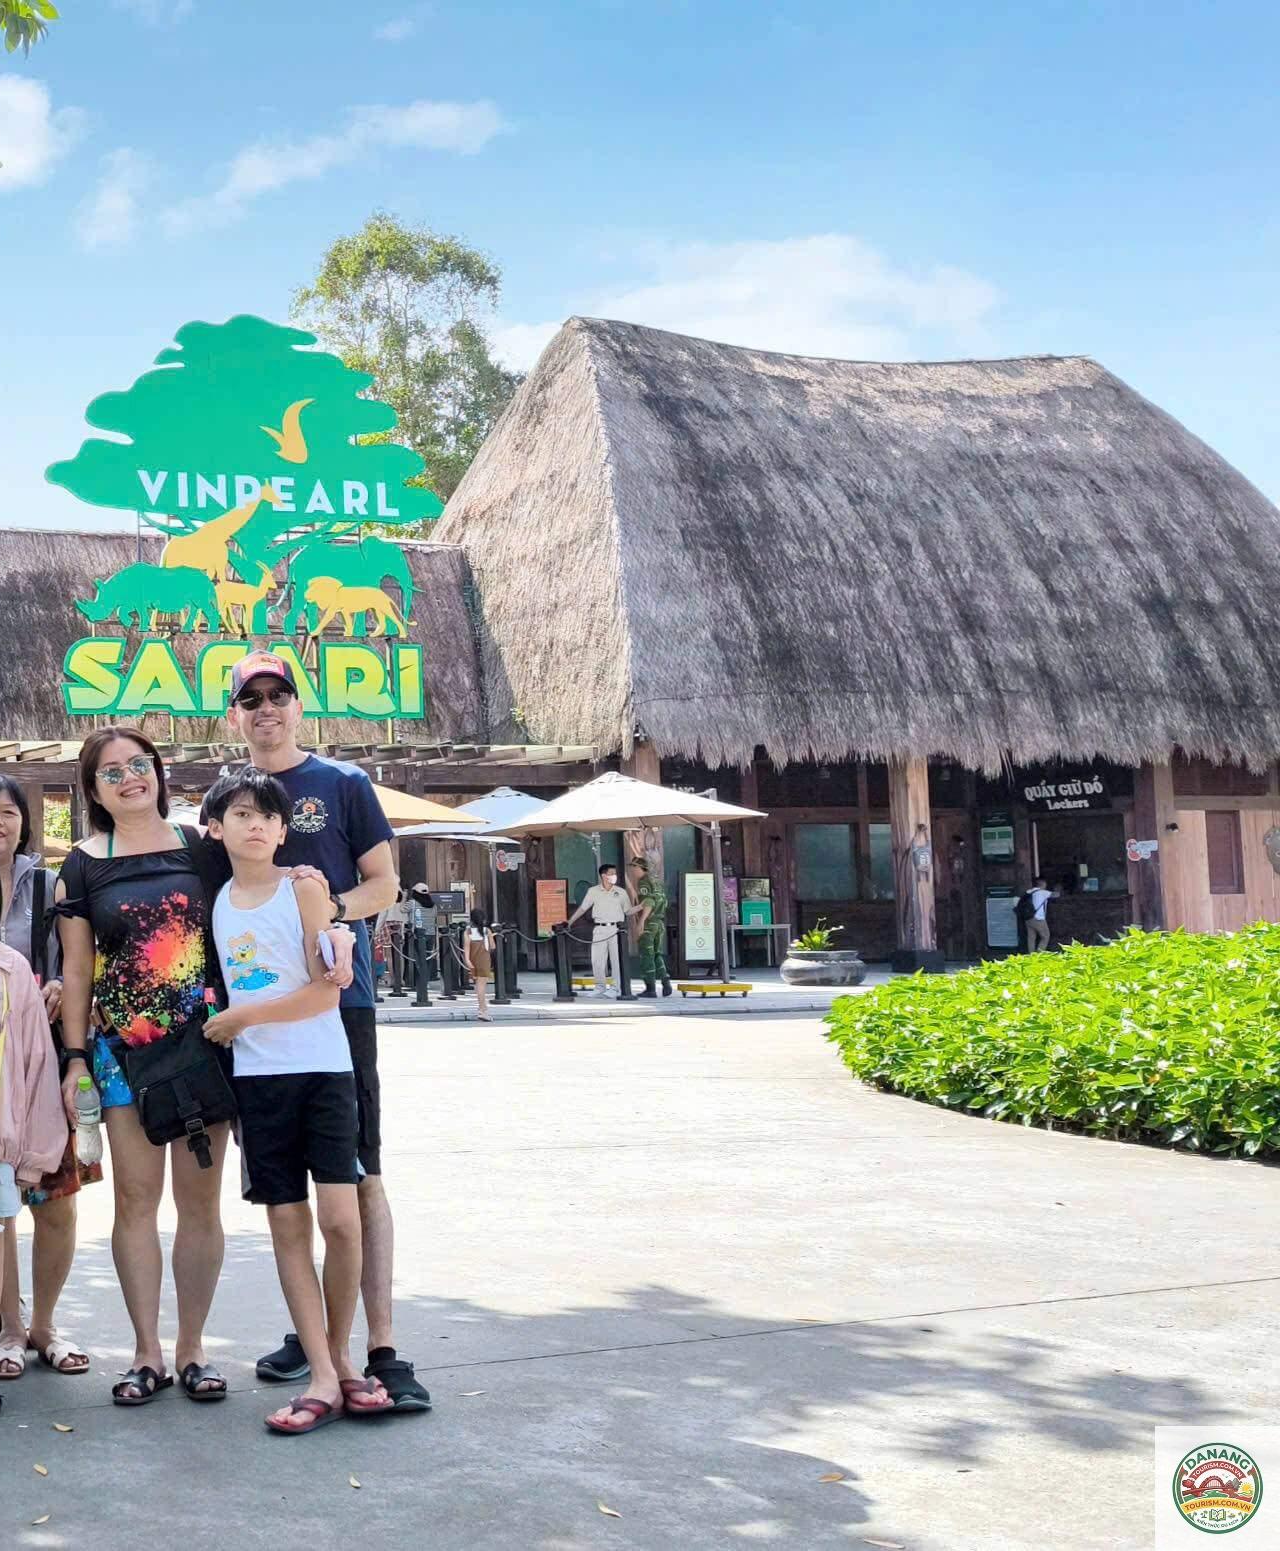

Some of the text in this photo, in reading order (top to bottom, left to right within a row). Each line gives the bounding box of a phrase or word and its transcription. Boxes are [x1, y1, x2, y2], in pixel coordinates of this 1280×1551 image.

[137, 469, 400, 517] VINPEARL
[62, 636, 424, 719] SAFARI
[1046, 798, 1090, 810] Lockers
